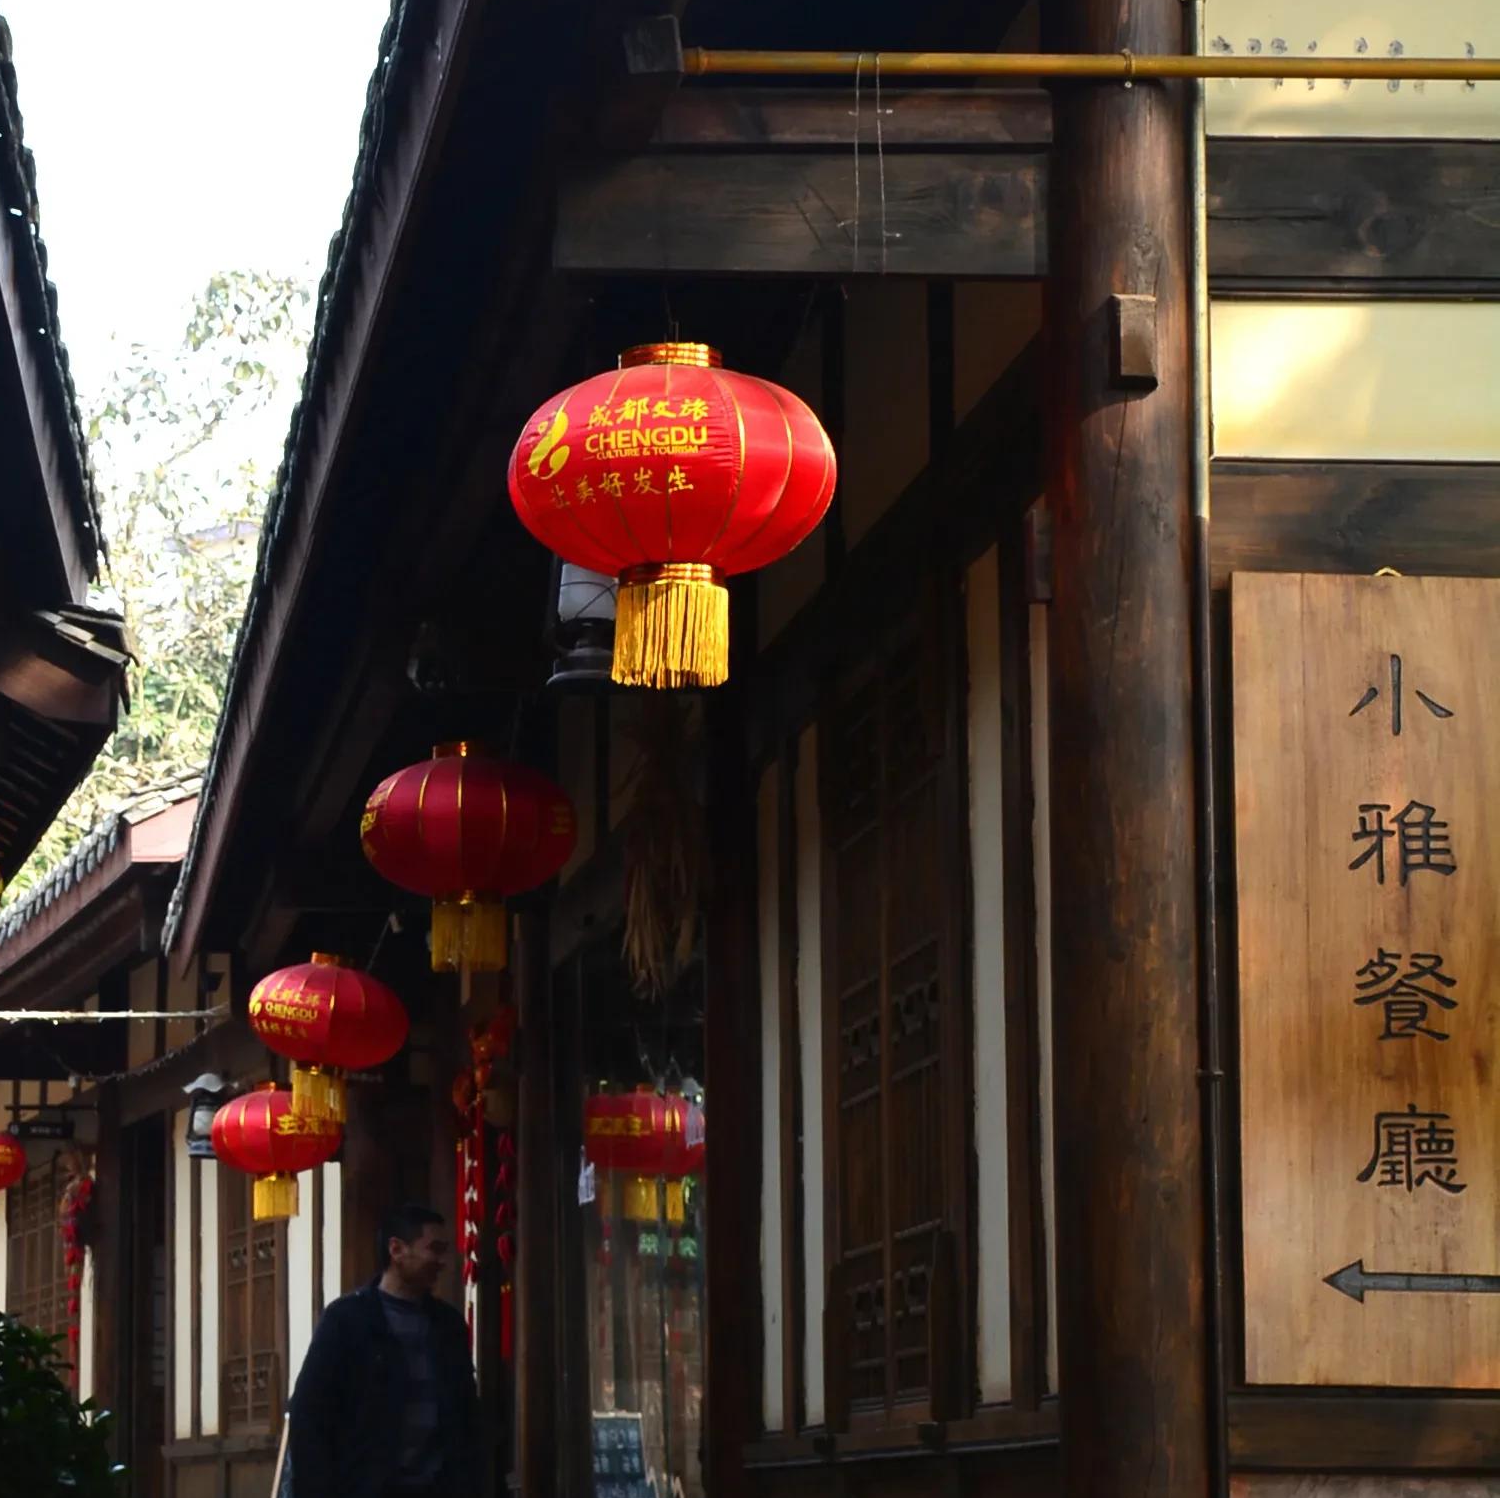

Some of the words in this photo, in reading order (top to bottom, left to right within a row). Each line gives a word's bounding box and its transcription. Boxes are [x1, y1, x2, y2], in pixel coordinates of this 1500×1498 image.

[587, 397, 709, 429] 成都文旅
[585, 425, 708, 453] CHENGDU
[596, 447, 640, 461] CULTURE
[643, 446, 651, 457] &
[653, 445, 699, 456] TOURISM
[550, 465, 694, 508] 让美好发生
[1349, 653, 1468, 1195] 小雅餐廳
[265, 1001, 318, 1020] CHENGDU
